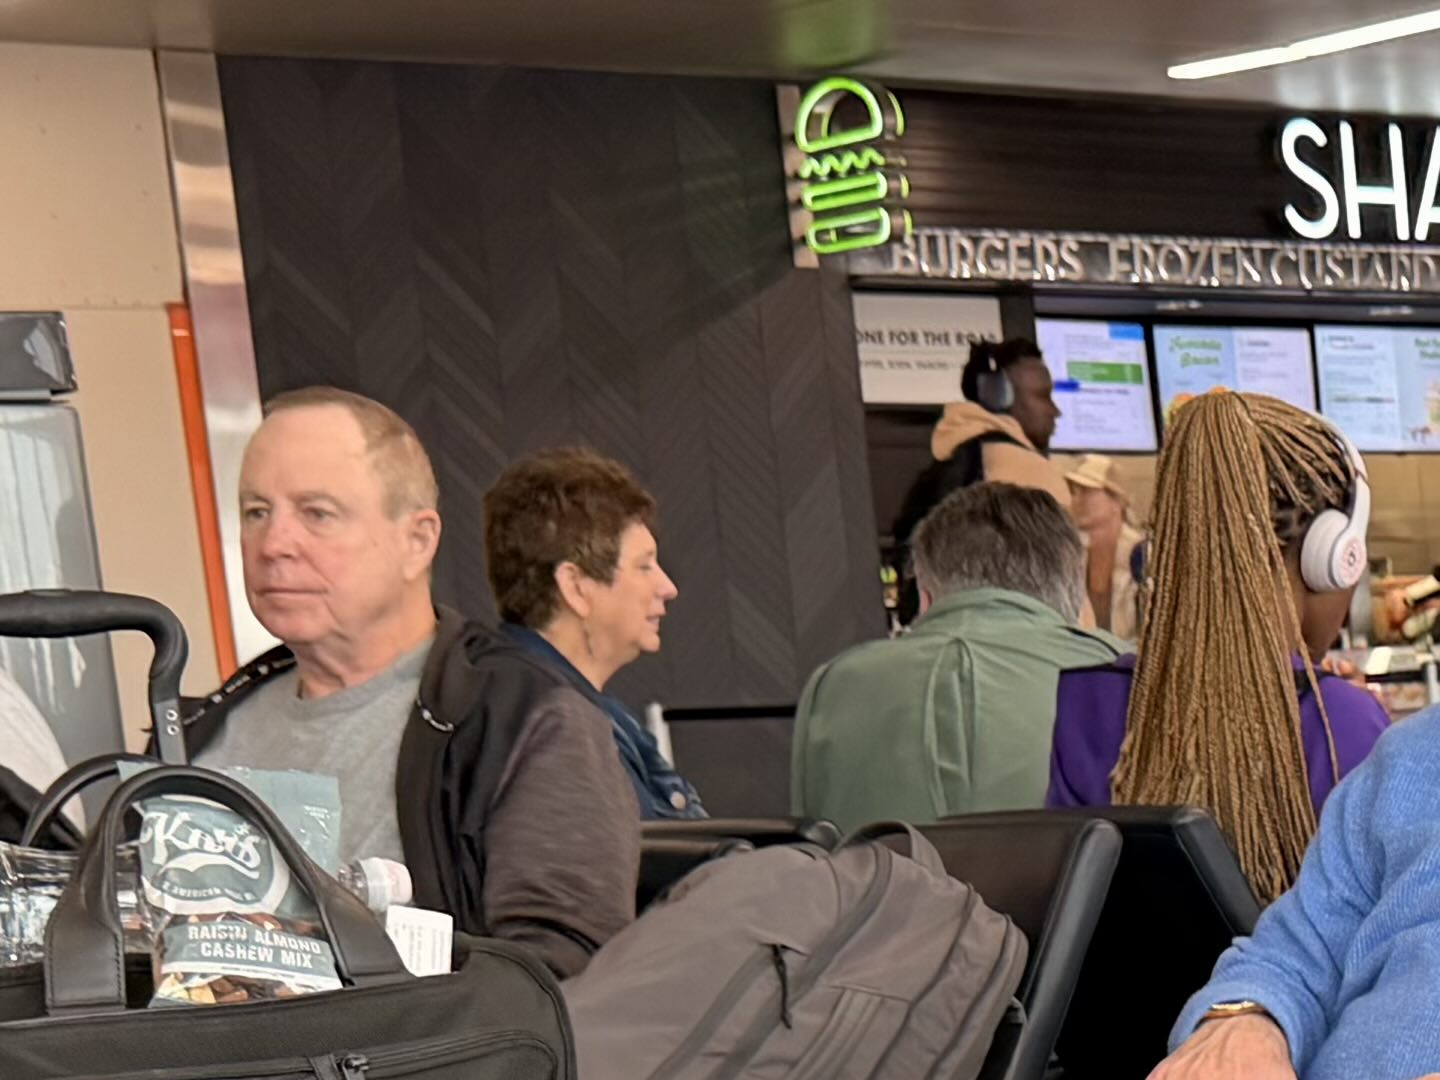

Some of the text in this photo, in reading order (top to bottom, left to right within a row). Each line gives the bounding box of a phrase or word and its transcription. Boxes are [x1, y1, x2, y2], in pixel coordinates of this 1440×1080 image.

[890, 232, 1085, 282] BURGERS
[1108, 238, 1262, 287] FROZEN
[889, 330, 918, 346] FOR
[922, 331, 951, 347] THE
[188, 922, 322, 954] RAISIN ALMOND
[200, 941, 313, 969] CASHEW MIX
